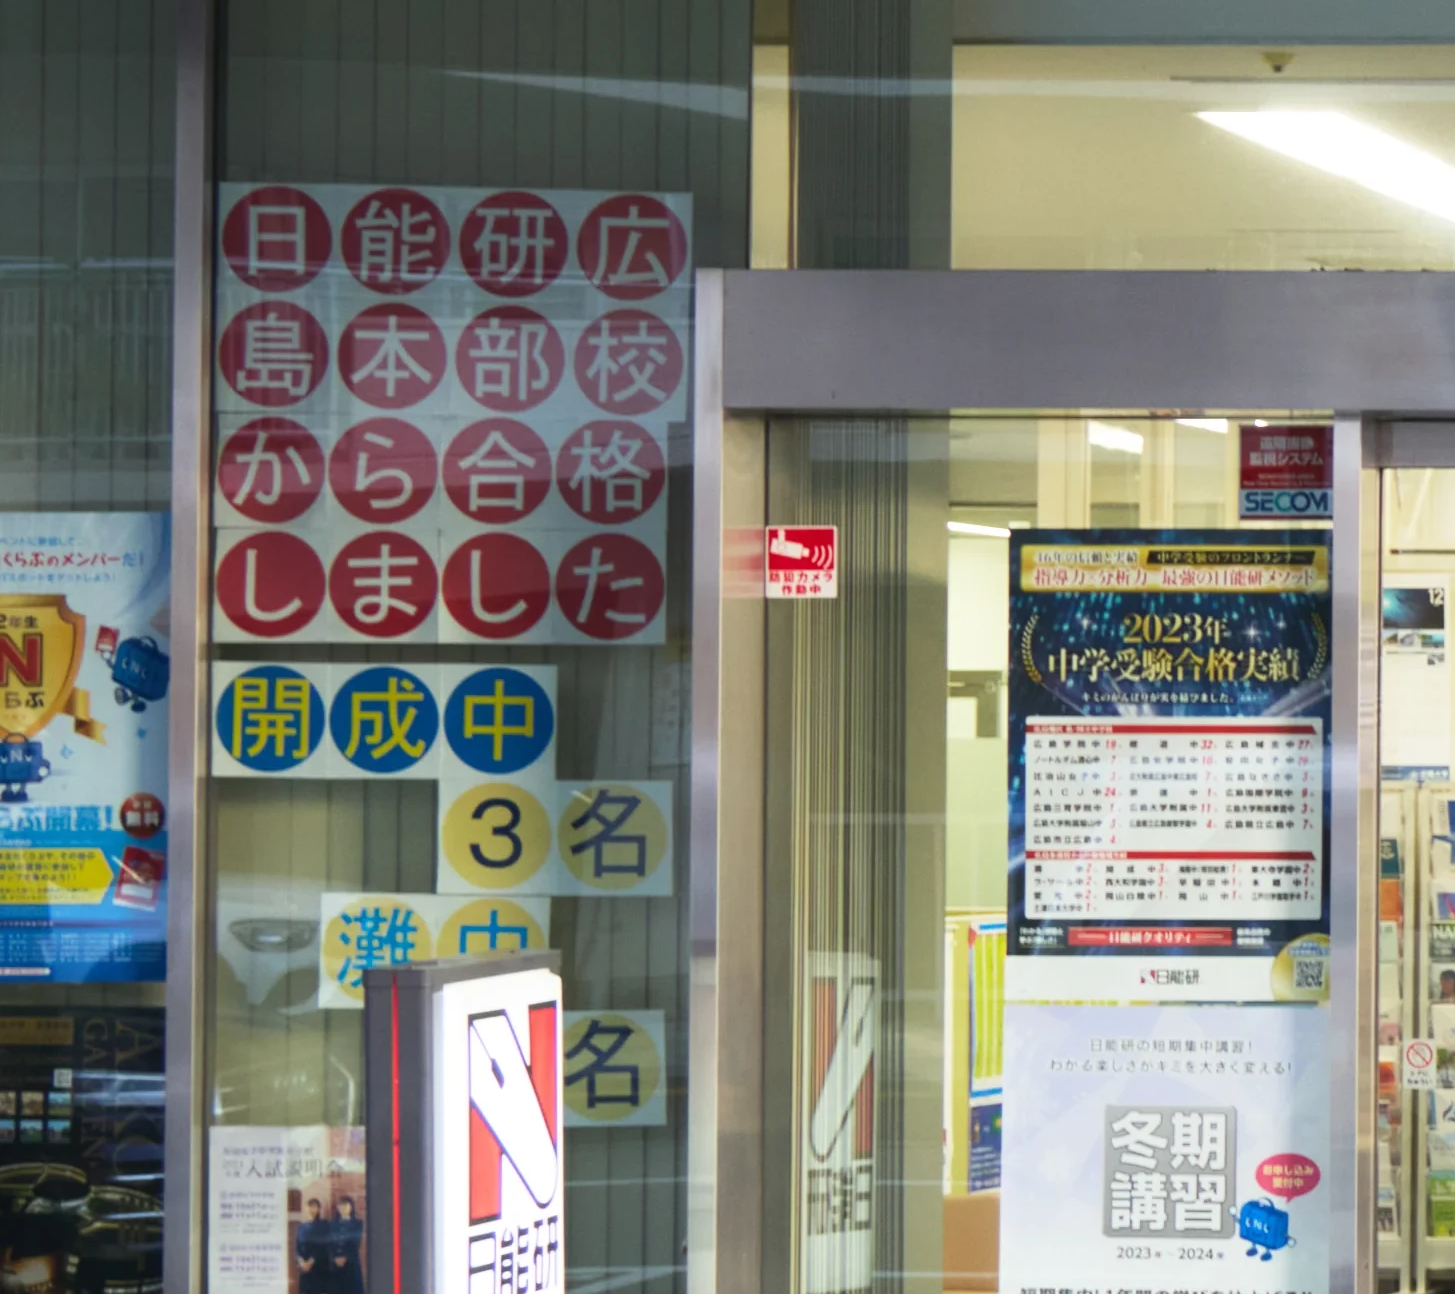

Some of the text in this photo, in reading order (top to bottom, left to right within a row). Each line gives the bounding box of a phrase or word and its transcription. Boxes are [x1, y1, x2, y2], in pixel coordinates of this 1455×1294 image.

[247, 199, 671, 287] 日能研広
[235, 311, 669, 404] 島本部校
[232, 429, 651, 513] から合格
[1244, 491, 1329, 513] SECOM
[244, 543, 646, 623] しました
[1047, 647, 1300, 683] 中学受験合格実績
[1122, 613, 1229, 644] 2023年
[231, 676, 535, 761] 開成中
[468, 788, 647, 879] 3名
[1155, 969, 1201, 985] 日能研
[564, 1019, 640, 1110] 名
[1110, 1110, 1227, 1170] 冬期
[1110, 1171, 1227, 1233] 講習
